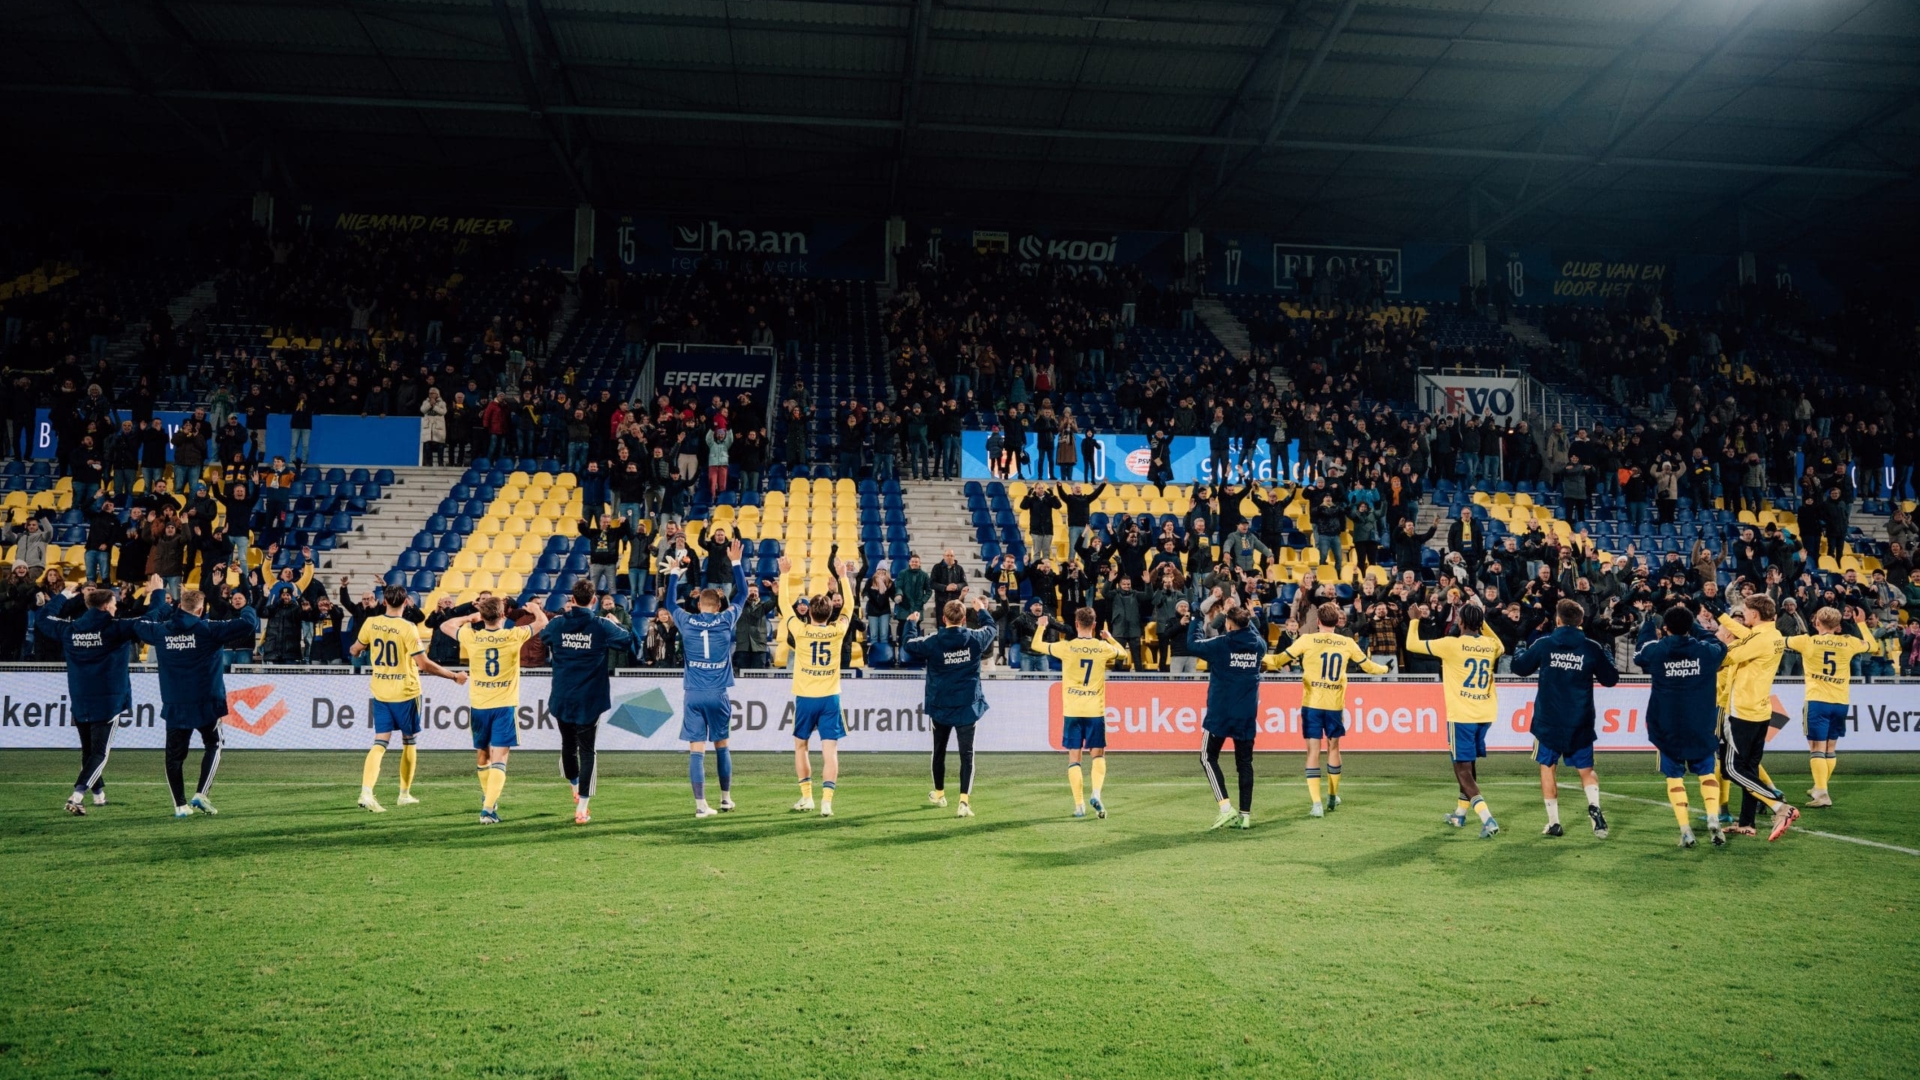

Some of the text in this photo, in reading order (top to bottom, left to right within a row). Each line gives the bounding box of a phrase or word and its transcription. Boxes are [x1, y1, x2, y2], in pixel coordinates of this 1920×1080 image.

[335, 212, 514, 236] NIEMAND IS MEER
[616, 226, 636, 265] 15
[708, 220, 809, 255] haan
[1225, 249, 1242, 286] 17
[1562, 261, 1666, 281] CLUB VAN EN
[1506, 261, 1524, 298] 18
[1553, 280, 1598, 297] VOOR
[1599, 281, 1633, 298] HET
[663, 371, 766, 389] EFFEKTIEF
[72, 632, 101, 640] voetbal
[73, 640, 103, 648] shop.nl
[165, 634, 195, 642] voetbal
[166, 641, 196, 650] shop.nl
[561, 632, 592, 642] voetbal
[562, 640, 591, 650] shop.nl
[700, 629, 710, 659] 1
[374, 637, 399, 667] 20
[485, 647, 500, 677] 8
[809, 641, 832, 666] 15
[1230, 652, 1258, 661] voetbal
[1550, 652, 1584, 663] voetbal
[1080, 658, 1093, 687] 7
[1229, 660, 1257, 669] shop.nl
[1320, 652, 1342, 682] 10
[1463, 657, 1490, 689] 26
[1550, 660, 1583, 671] shop.nl
[1664, 658, 1700, 669] voetbal
[1665, 667, 1700, 677] shop.nl
[1822, 651, 1837, 677] 5
[312, 697, 355, 729] De
